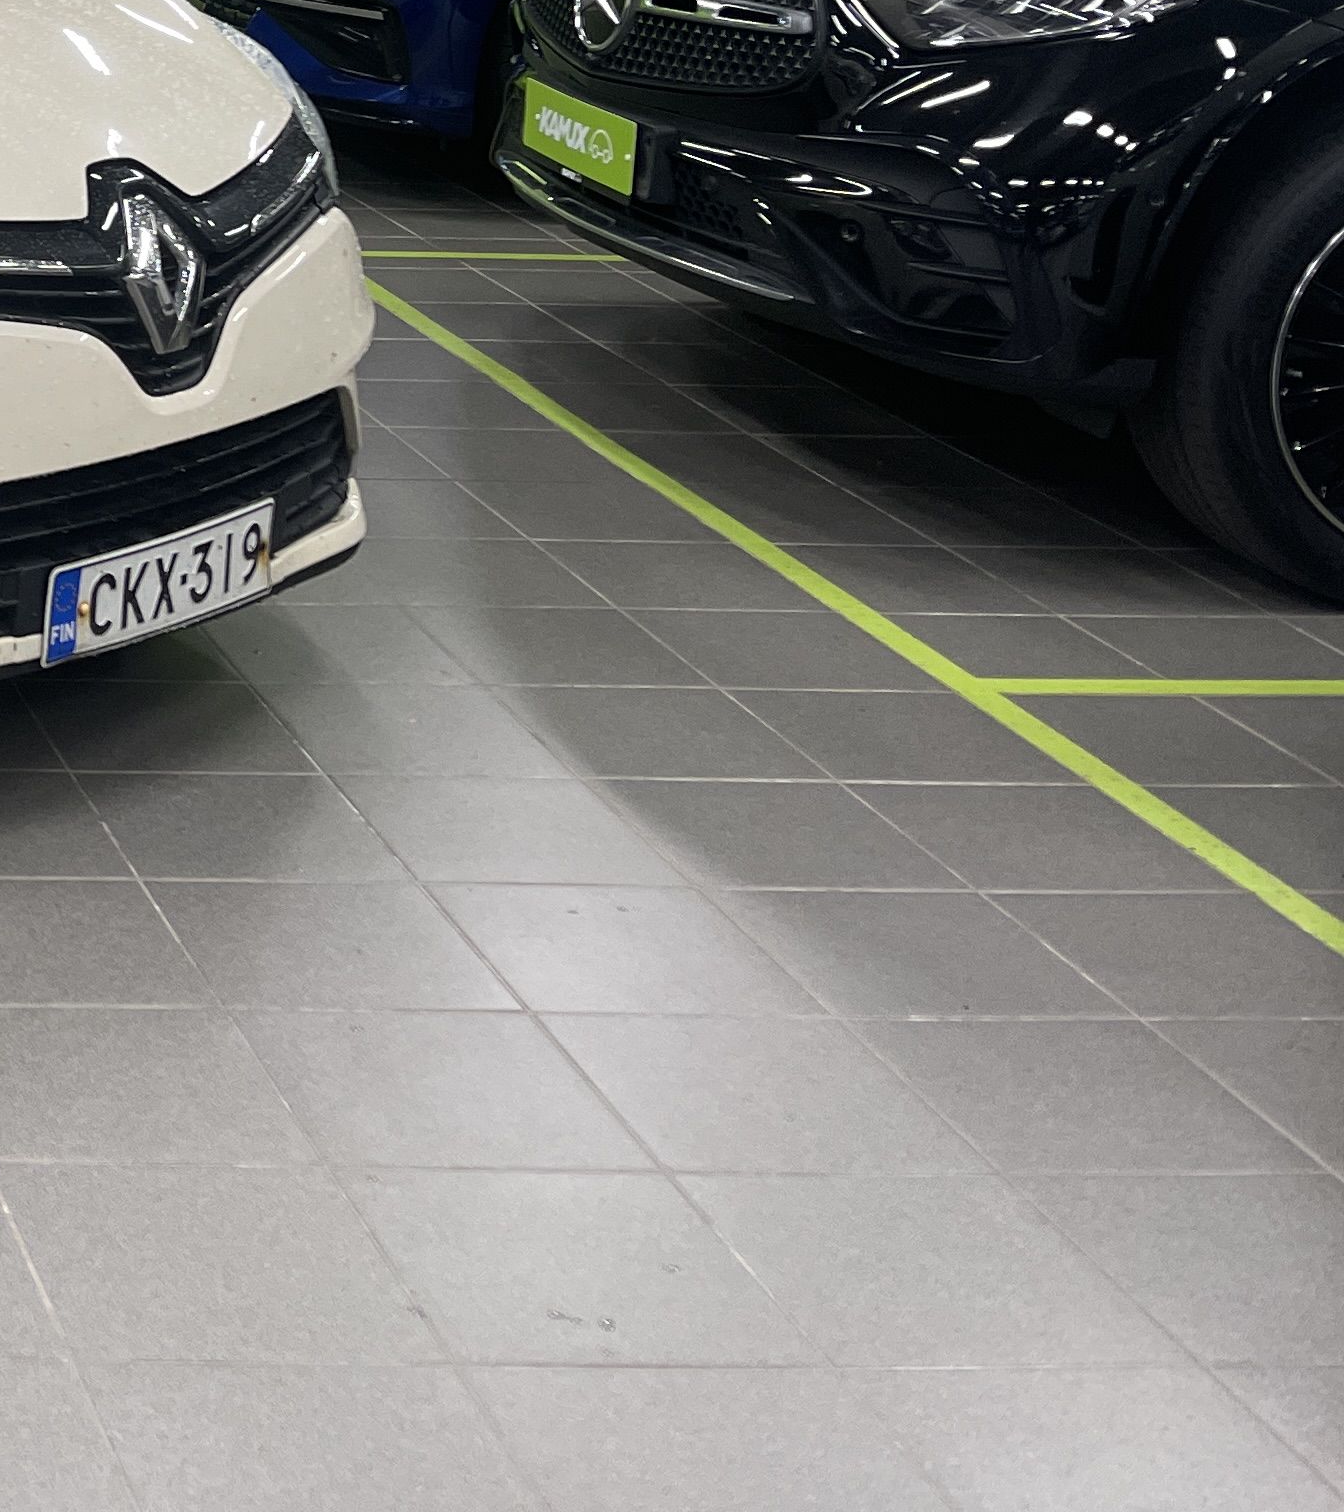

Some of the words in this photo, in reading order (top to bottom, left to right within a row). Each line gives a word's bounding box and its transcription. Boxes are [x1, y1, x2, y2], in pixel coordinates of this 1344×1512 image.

[538, 106, 591, 154] KAMUX
[50, 620, 76, 647] FIN
[89, 522, 261, 636] CKX-319
